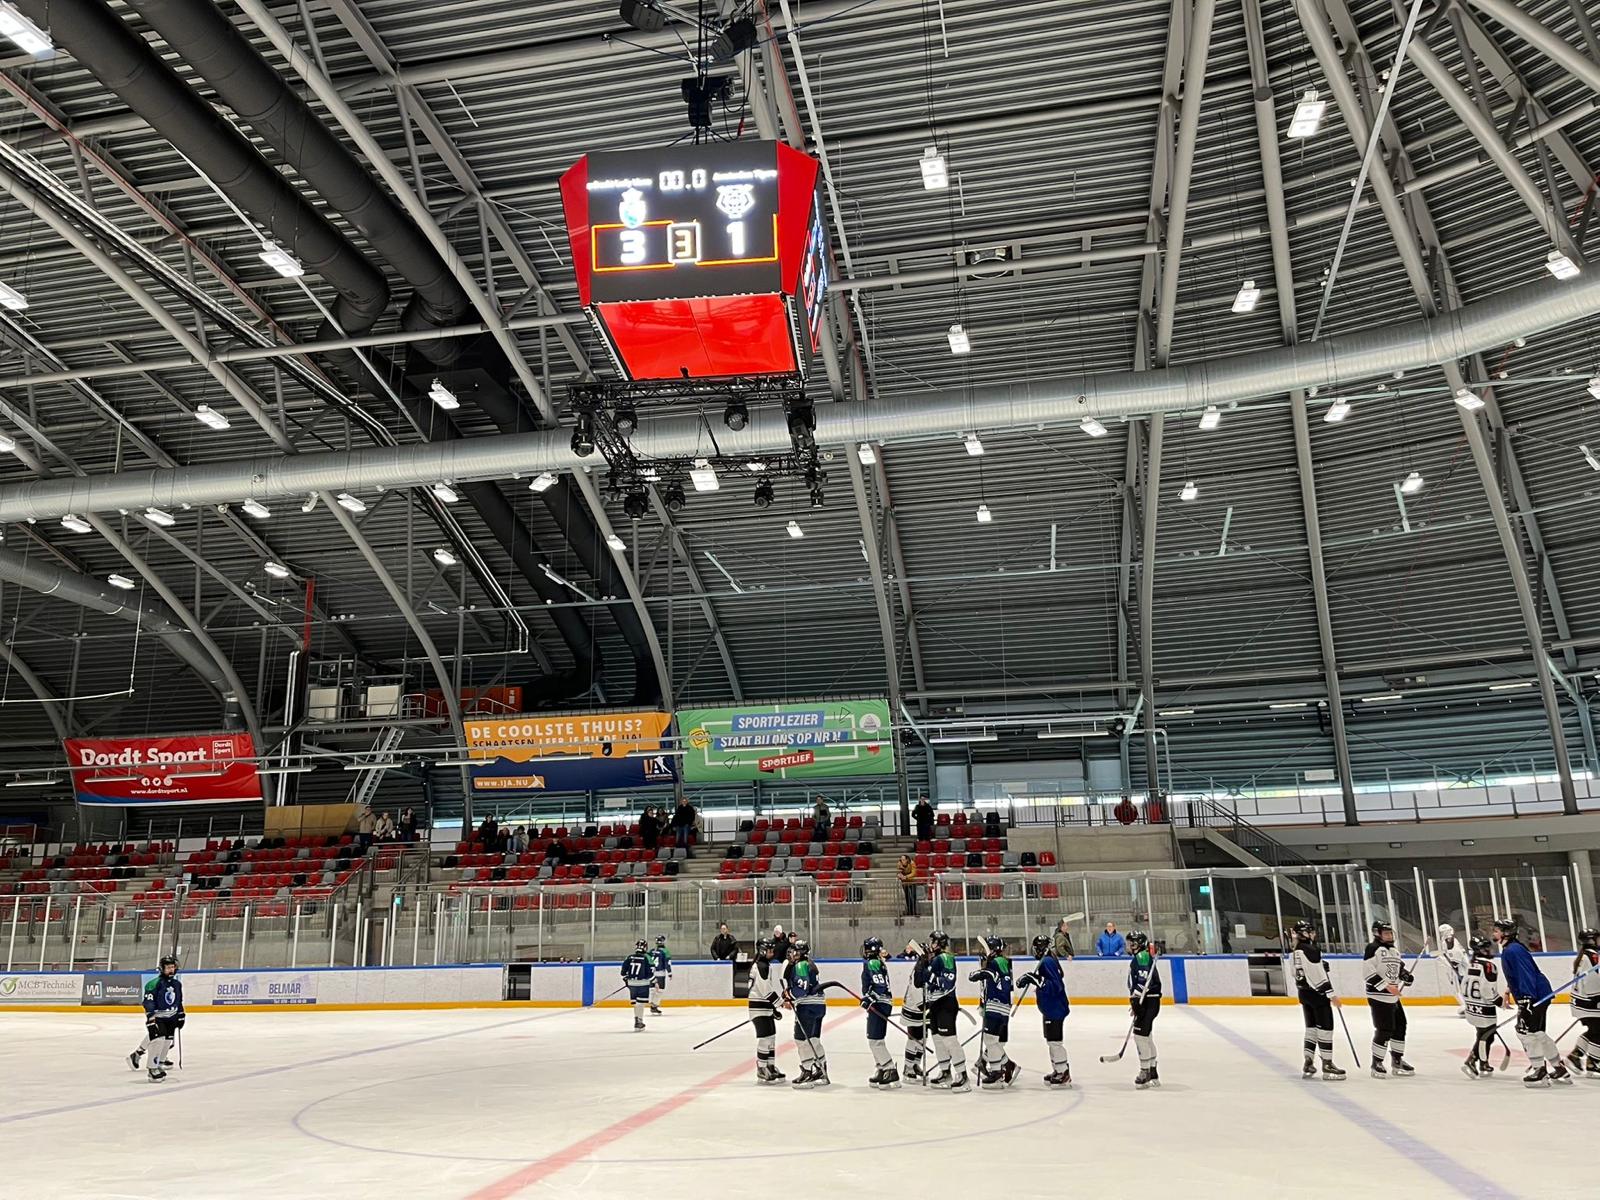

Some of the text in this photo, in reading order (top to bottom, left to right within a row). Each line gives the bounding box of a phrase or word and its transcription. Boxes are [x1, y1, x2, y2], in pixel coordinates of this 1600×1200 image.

[675, 229, 692, 258] 3
[726, 221, 745, 255] 1
[620, 229, 646, 264] 3
[471, 719, 642, 739] DE COOLSTE THUIS?
[738, 713, 819, 729] SPORTPLEZIER
[720, 735, 753, 748] STAAT
[754, 734, 770, 745] BIJ
[771, 733, 794, 745] ONS
[796, 732, 812, 744] OP
[814, 731, 830, 743] NR
[80, 747, 207, 770] Dordt Sport
[762, 753, 811, 768] SPORTLIEF
[629, 962, 642, 975] 77
[41, 980, 76, 989] Techniek
[106, 985, 140, 994] Webmyday
[217, 983, 249, 995] BELMAR
[268, 982, 301, 995] BELMAR
[1463, 980, 1482, 999] 16
